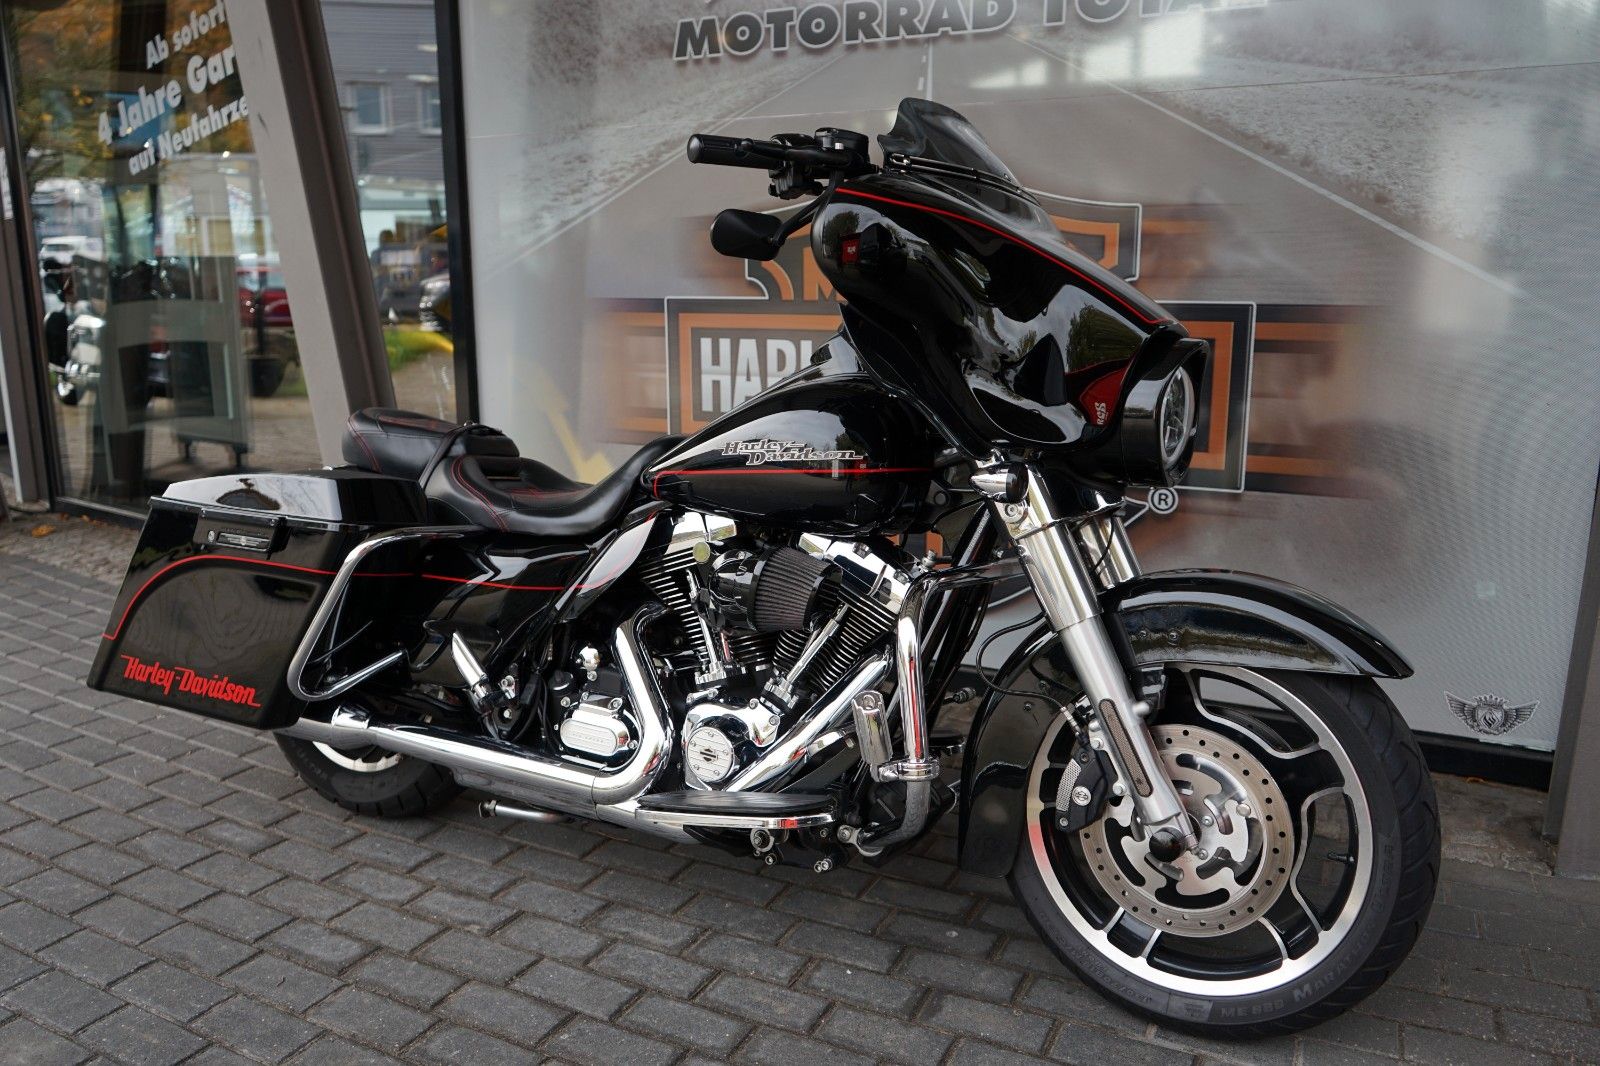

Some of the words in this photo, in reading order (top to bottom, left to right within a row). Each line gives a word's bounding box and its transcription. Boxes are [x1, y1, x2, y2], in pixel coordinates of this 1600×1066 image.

[146, 34, 169, 69] Ab
[172, 0, 226, 52] sofort
[673, 0, 1018, 61] MOTORRAD
[98, 111, 112, 145] 4
[118, 80, 182, 137] Jahre
[187, 45, 235, 94] Gar
[129, 138, 155, 176] auf
[157, 95, 249, 160] Neufahrze
[746, 448, 864, 466] Davidson
[121, 654, 261, 708] Harley-Davidson
